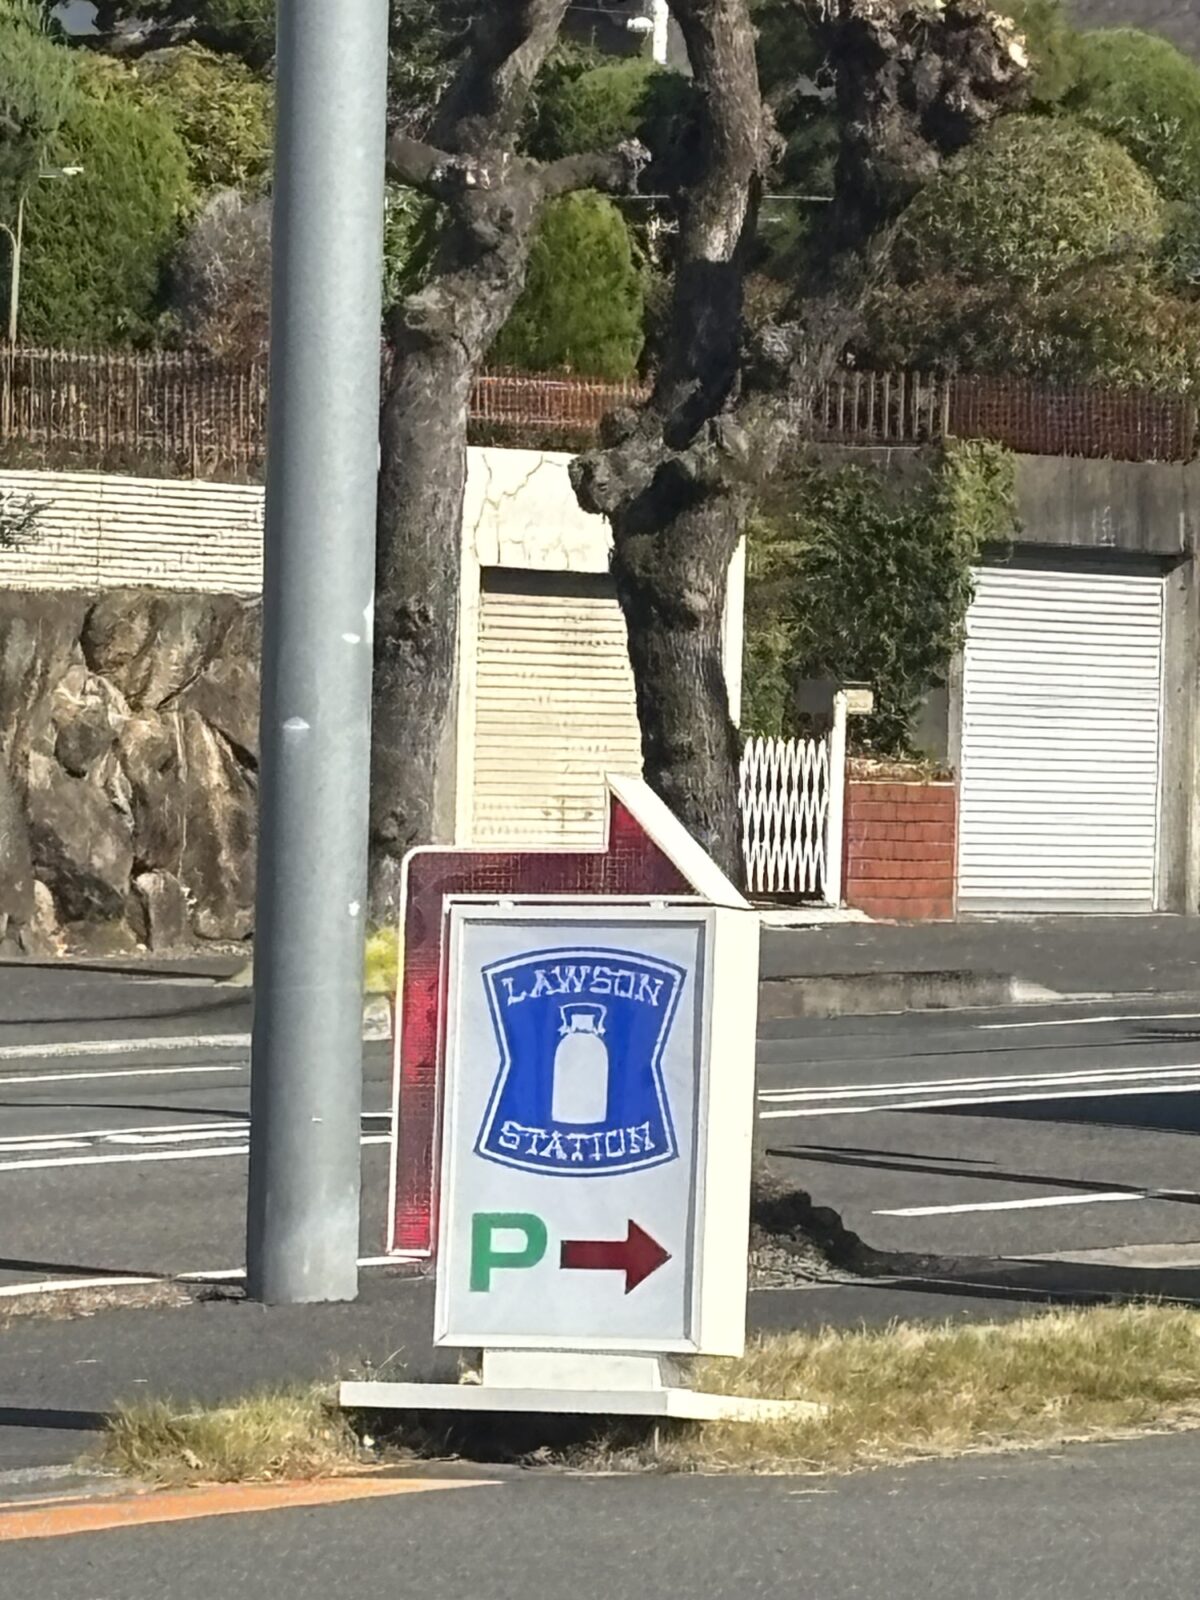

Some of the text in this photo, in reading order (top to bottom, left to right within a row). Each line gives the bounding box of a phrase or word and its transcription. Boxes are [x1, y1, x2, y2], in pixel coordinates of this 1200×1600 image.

[501, 965, 664, 1006] LAWSON
[498, 1120, 655, 1161] STATION
[469, 1212, 548, 1292] P
